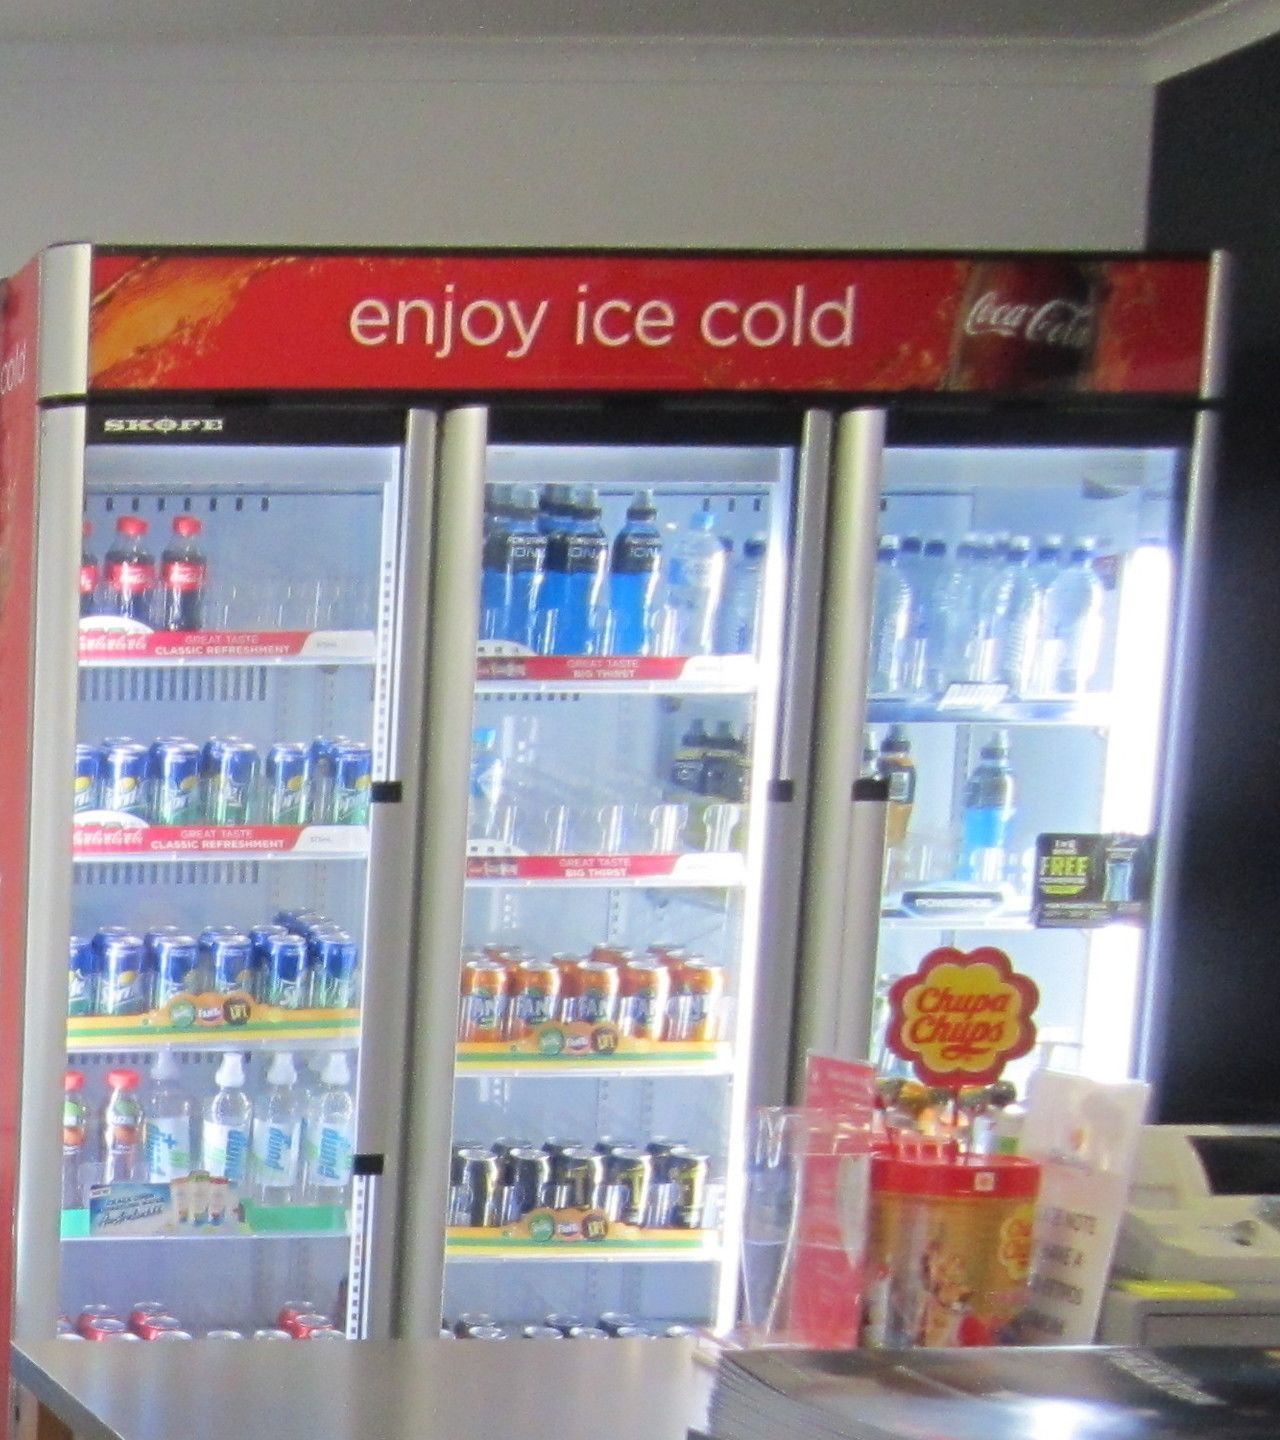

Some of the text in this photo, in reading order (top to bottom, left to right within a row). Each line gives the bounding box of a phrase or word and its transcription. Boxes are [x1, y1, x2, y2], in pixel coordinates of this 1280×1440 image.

[349, 284, 857, 359] enjoy ice cold
[102, 415, 224, 434] SKOPE
[154, 645, 204, 656] CLASSIC
[206, 645, 290, 656] REFRESHMENT
[150, 839, 285, 850] CLASSIC REFRESHMENT
[916, 986, 1012, 1020] Chupa
[910, 1014, 1007, 1052] Chups
[264, 1126, 290, 1171] pump
[317, 1127, 343, 1180] pump
